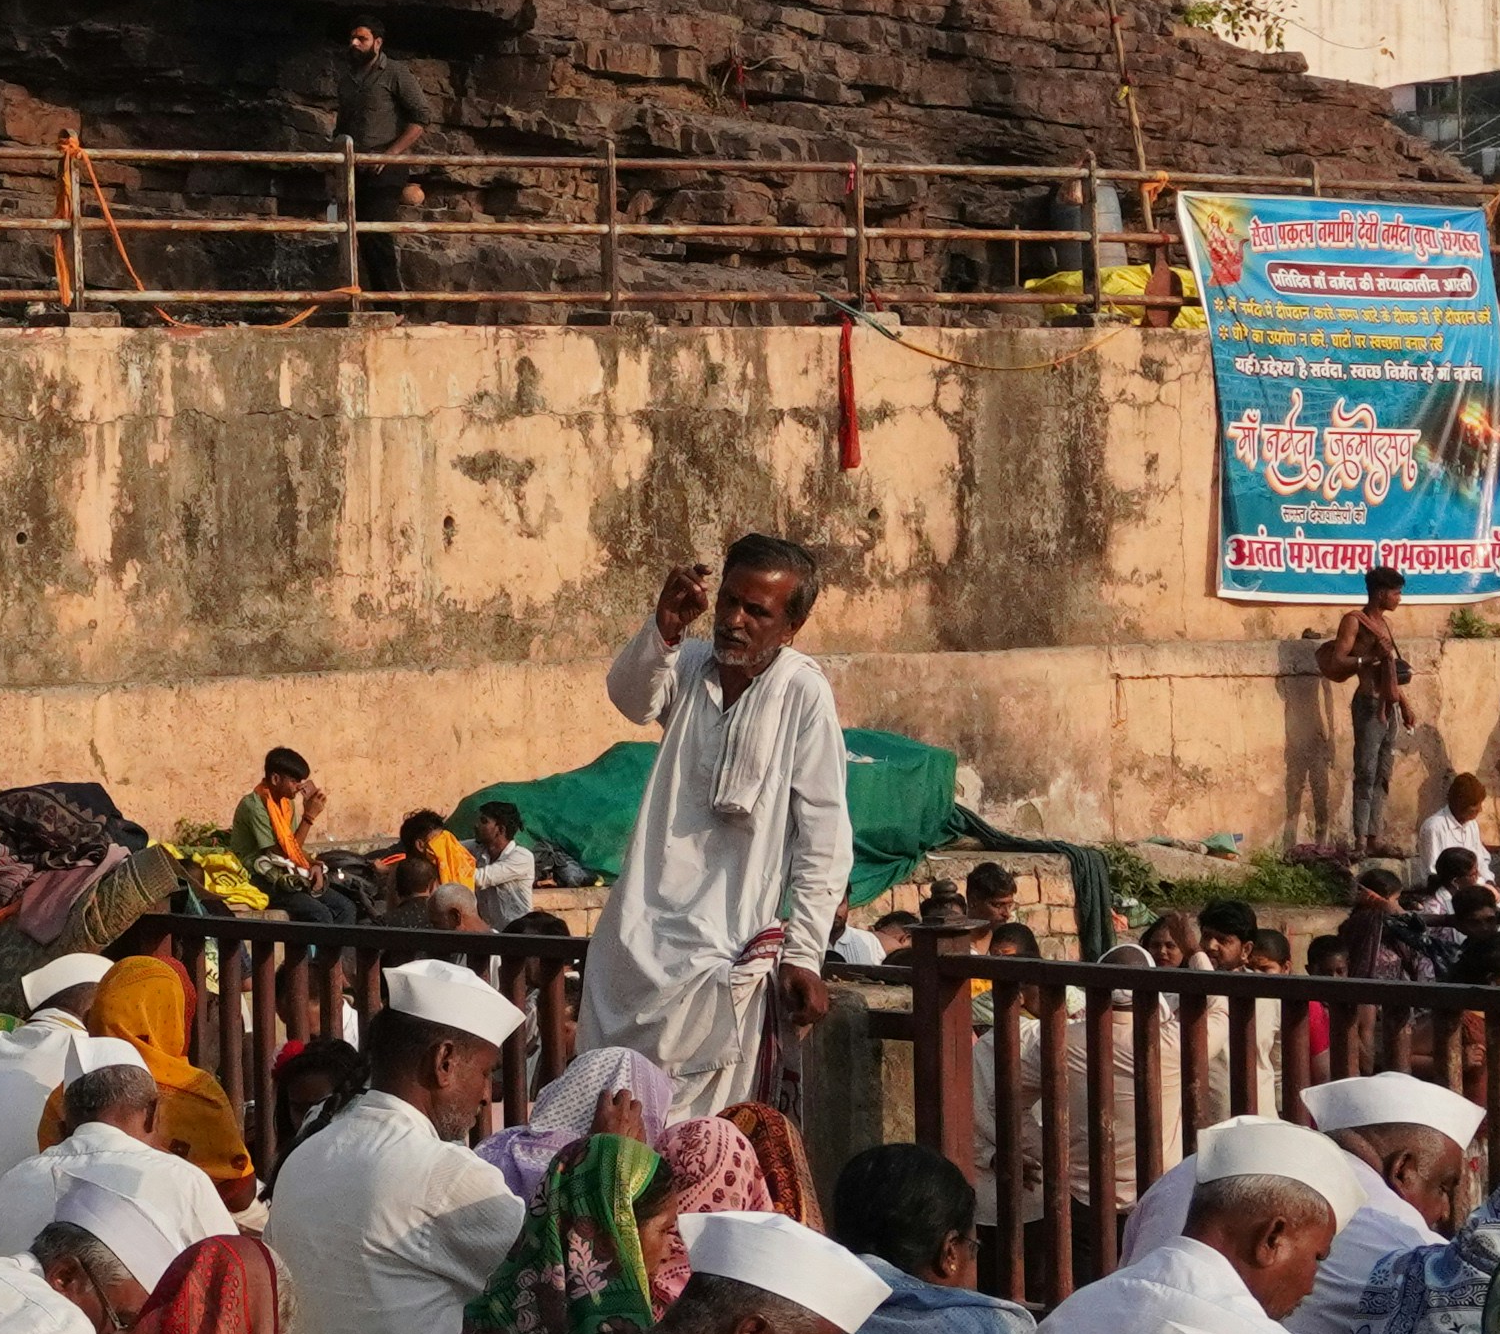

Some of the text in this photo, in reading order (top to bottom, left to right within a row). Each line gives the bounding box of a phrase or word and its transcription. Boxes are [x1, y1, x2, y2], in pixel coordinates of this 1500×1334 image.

[1250, 218, 1277, 249] सेवा
[1317, 211, 1355, 246] नमामि
[1357, 212, 1380, 247] देवी
[1381, 215, 1412, 248] नर्मदा
[1413, 226, 1440, 259] युवा
[1270, 269, 1312, 288] प्रतिदिन
[1328, 272, 1358, 290] नर्मदा
[1358, 273, 1375, 291] की
[1441, 274, 1473, 292] आरती
[1381, 305, 1391, 323] के
[1250, 328, 1264, 344] का
[1298, 332, 1309, 347] न
[1353, 333, 1367, 349] पर
[1295, 355, 1308, 380] है
[1349, 364, 1383, 381] स्वच्छ
[1419, 359, 1436, 384] रहे
[1227, 388, 1421, 505] माँ नर्मदा जन्मोत्सव
[1354, 501, 1367, 525] को
[1226, 524, 1285, 572] अनंत
[1286, 527, 1375, 574] मंगलमय
